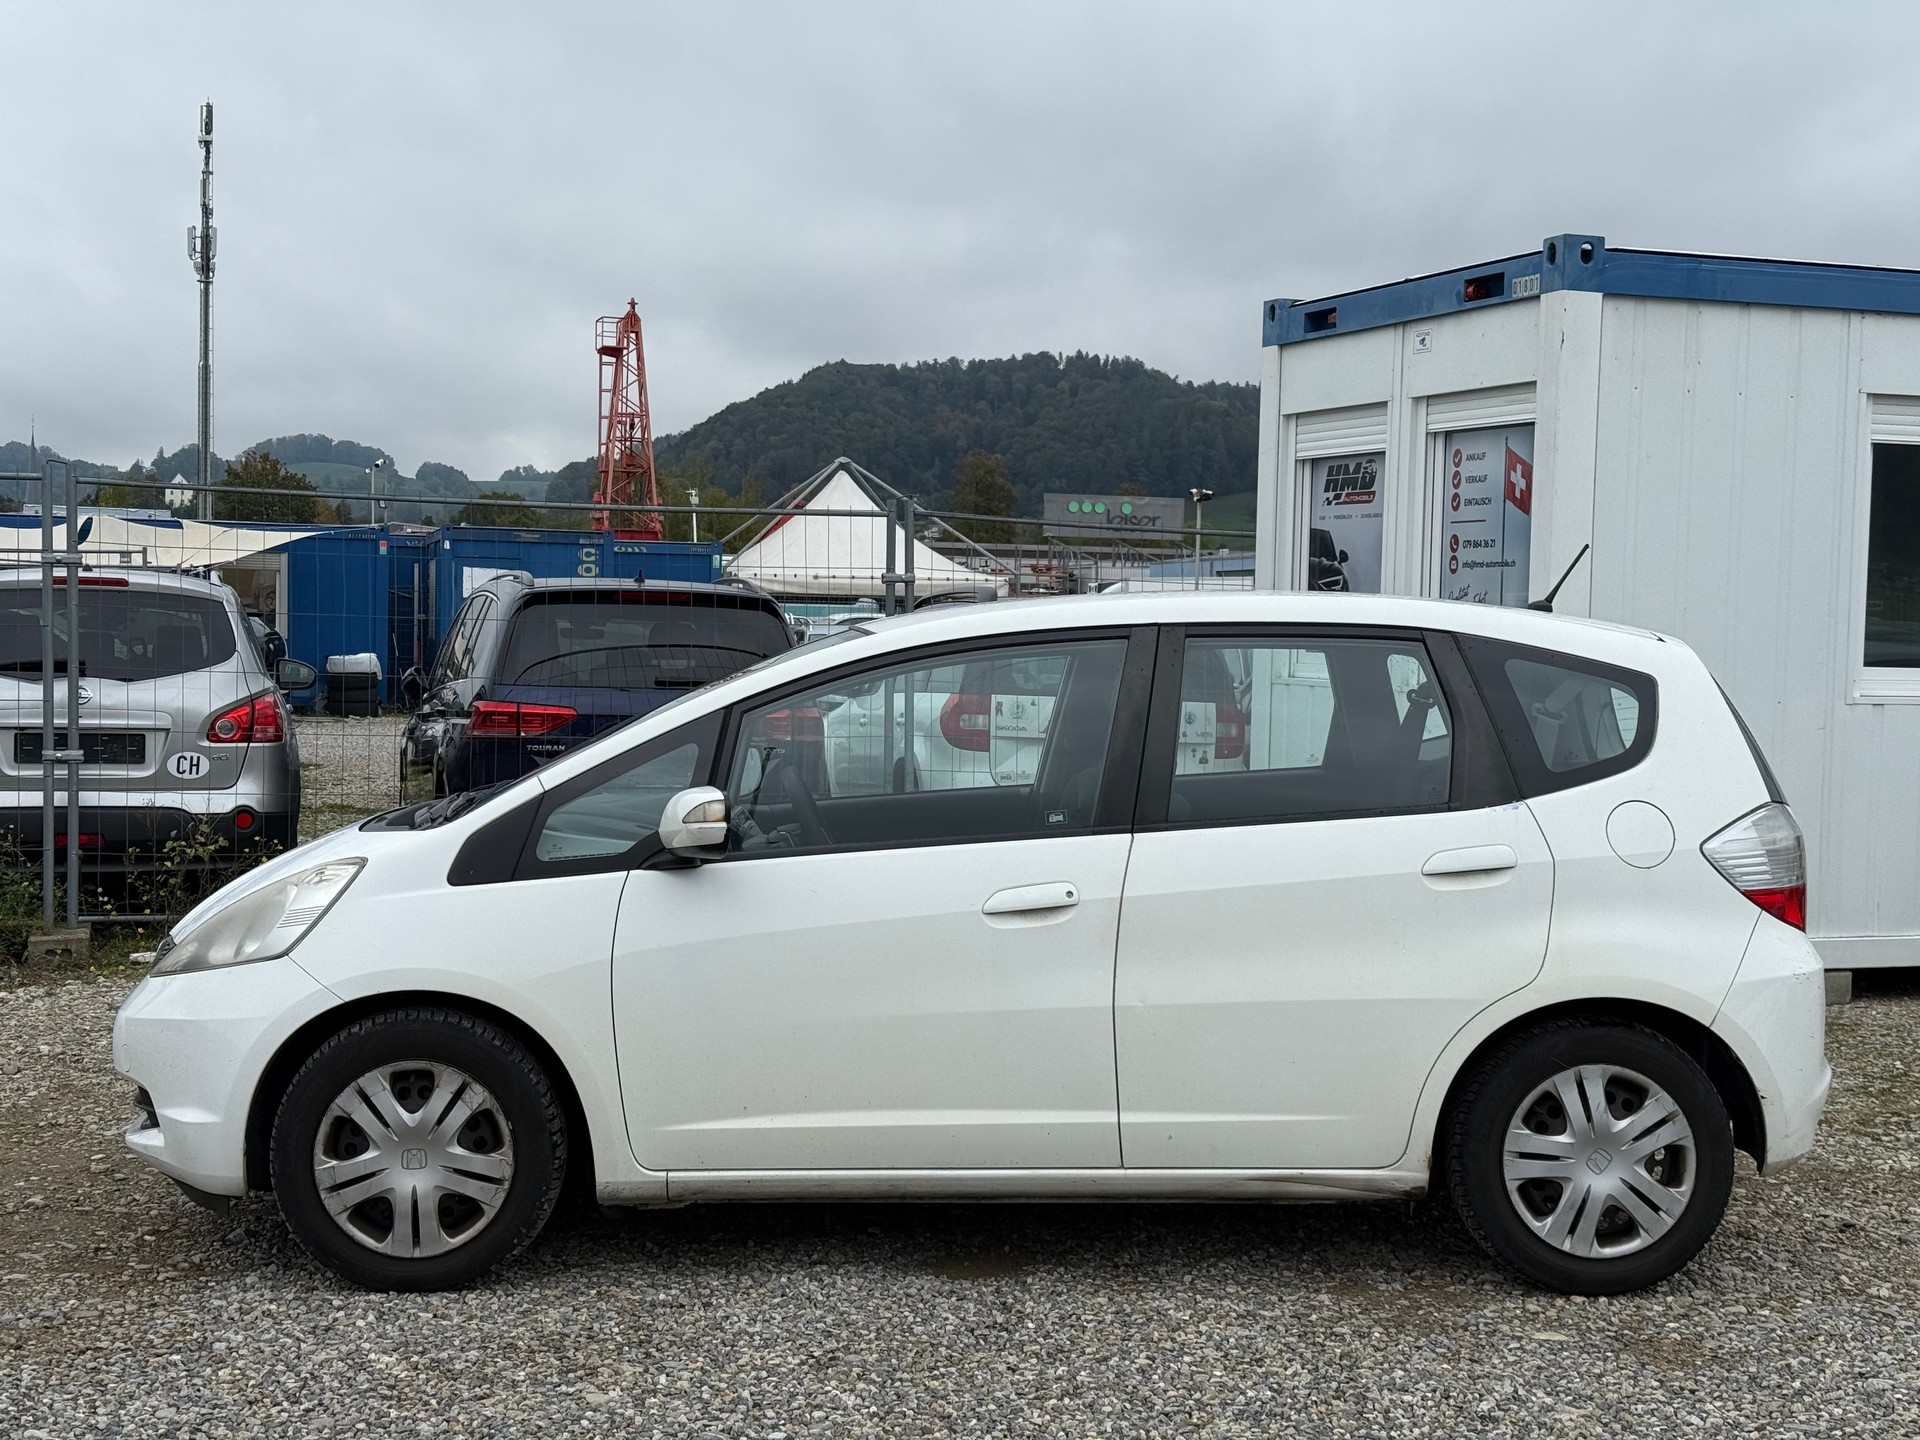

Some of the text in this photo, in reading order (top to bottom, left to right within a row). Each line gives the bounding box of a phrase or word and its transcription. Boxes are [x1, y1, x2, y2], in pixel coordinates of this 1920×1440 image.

[1465, 452, 1487, 462] ANKAUF
[1323, 459, 1378, 493] HMD
[1464, 474, 1488, 484] VERKAUF
[1464, 497, 1492, 507] EINTAUSCH
[176, 755, 201, 776] CH
